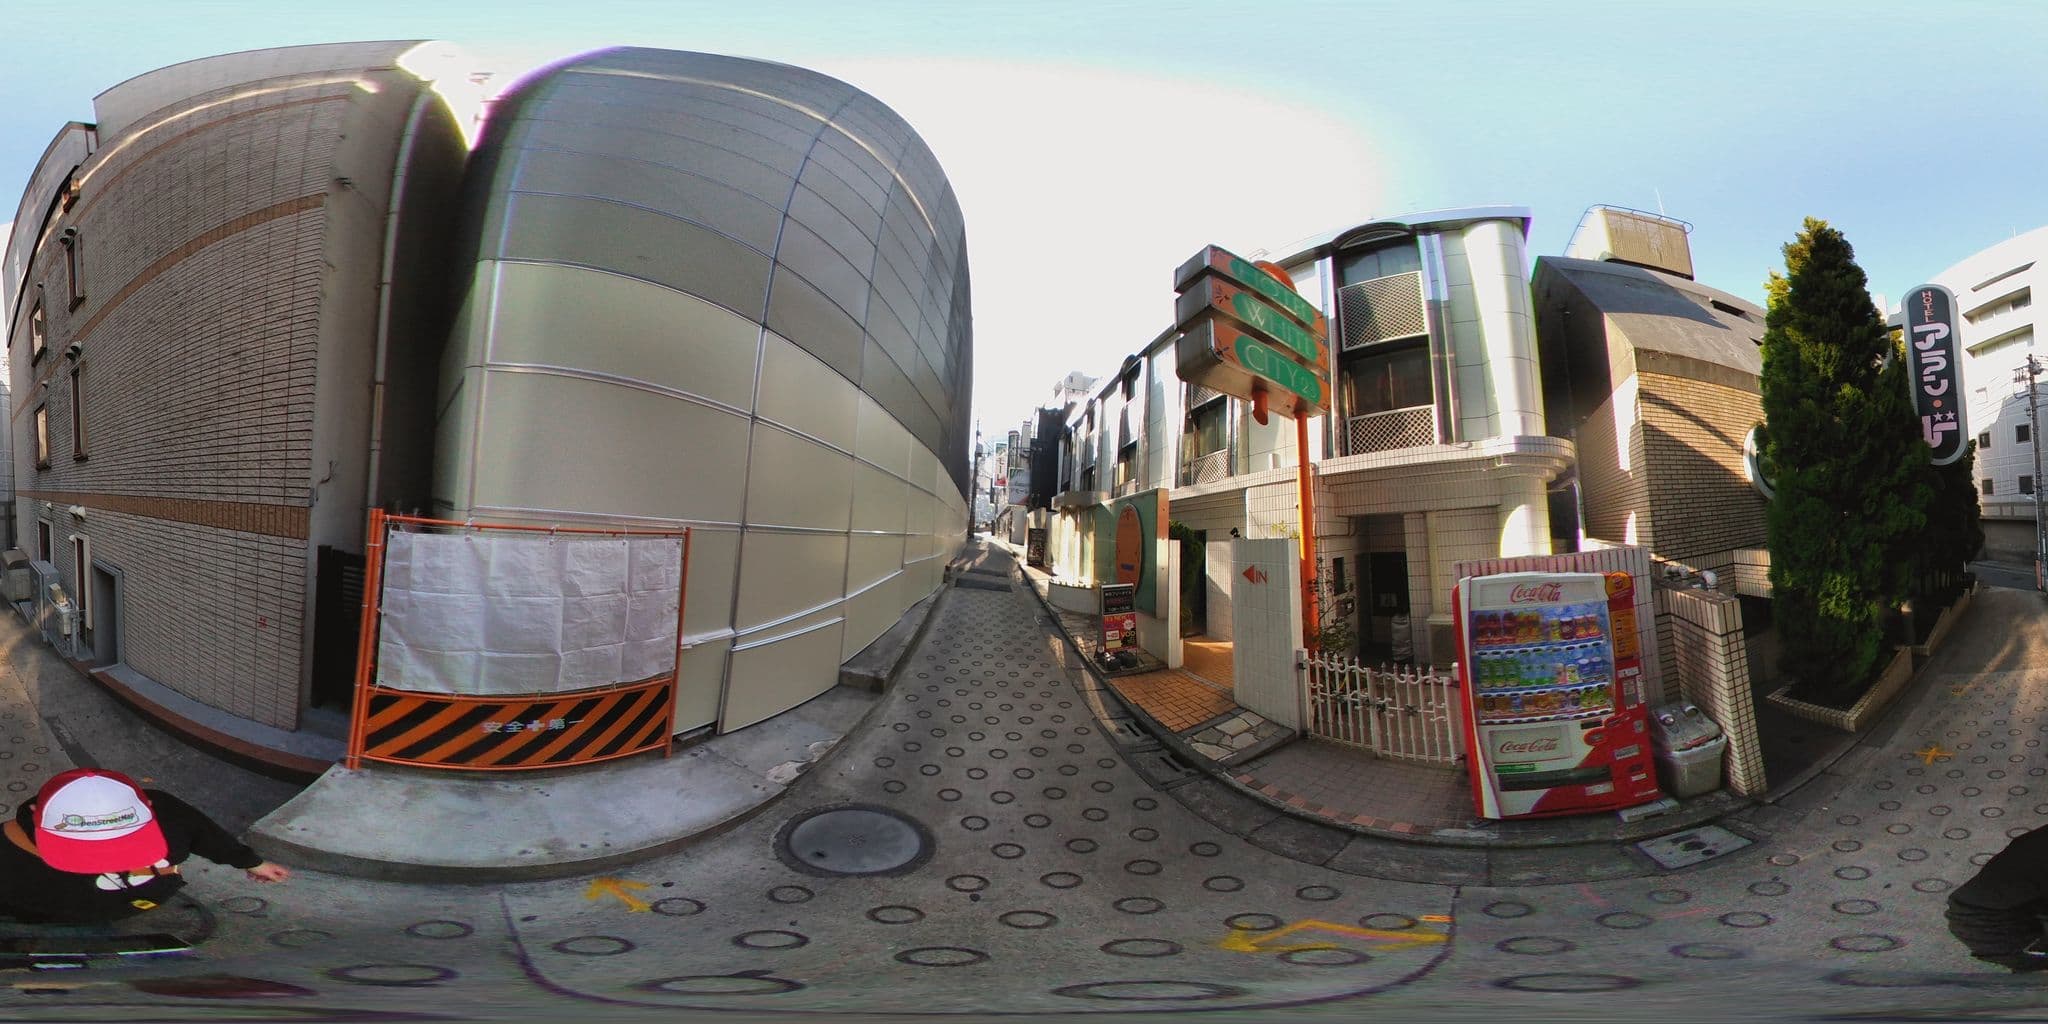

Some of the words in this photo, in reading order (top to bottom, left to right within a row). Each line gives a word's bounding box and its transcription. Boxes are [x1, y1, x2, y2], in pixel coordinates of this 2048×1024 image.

[1920, 290, 1936, 323] HOTEL
[1246, 344, 1299, 389] CITY
[1255, 569, 1269, 585] IN
[481, 721, 525, 733] 安全
[548, 718, 585, 730] 第一
